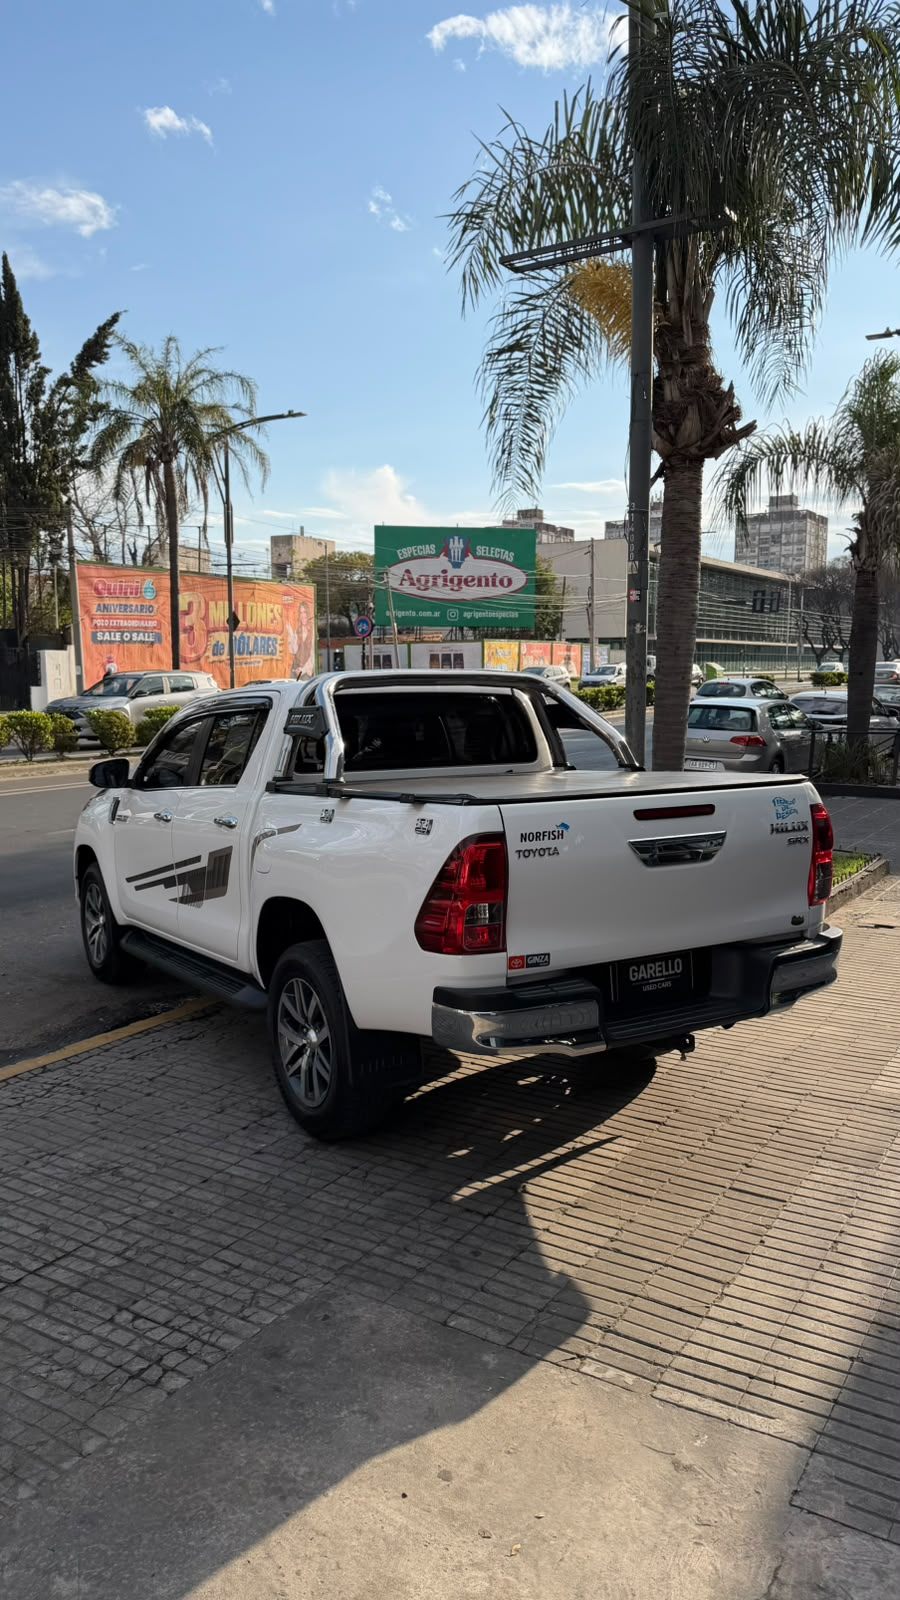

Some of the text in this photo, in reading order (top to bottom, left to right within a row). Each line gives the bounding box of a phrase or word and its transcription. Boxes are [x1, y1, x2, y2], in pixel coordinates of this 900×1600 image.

[396, 544, 515, 562] ESPECIAS SELECTAS
[398, 568, 513, 592] Agrigento
[94, 579, 140, 597] Quini
[95, 603, 155, 614] ANIVERSARIO
[178, 591, 208, 664] 3
[97, 631, 155, 642] SALE O SALE
[211, 640, 225, 657] de
[520, 829, 565, 843] NORFISH
[515, 846, 560, 860] TOYOTA
[527, 954, 550, 964] GINZA
[629, 958, 682, 981] GARELLO
[642, 981, 672, 992] USED CARS
